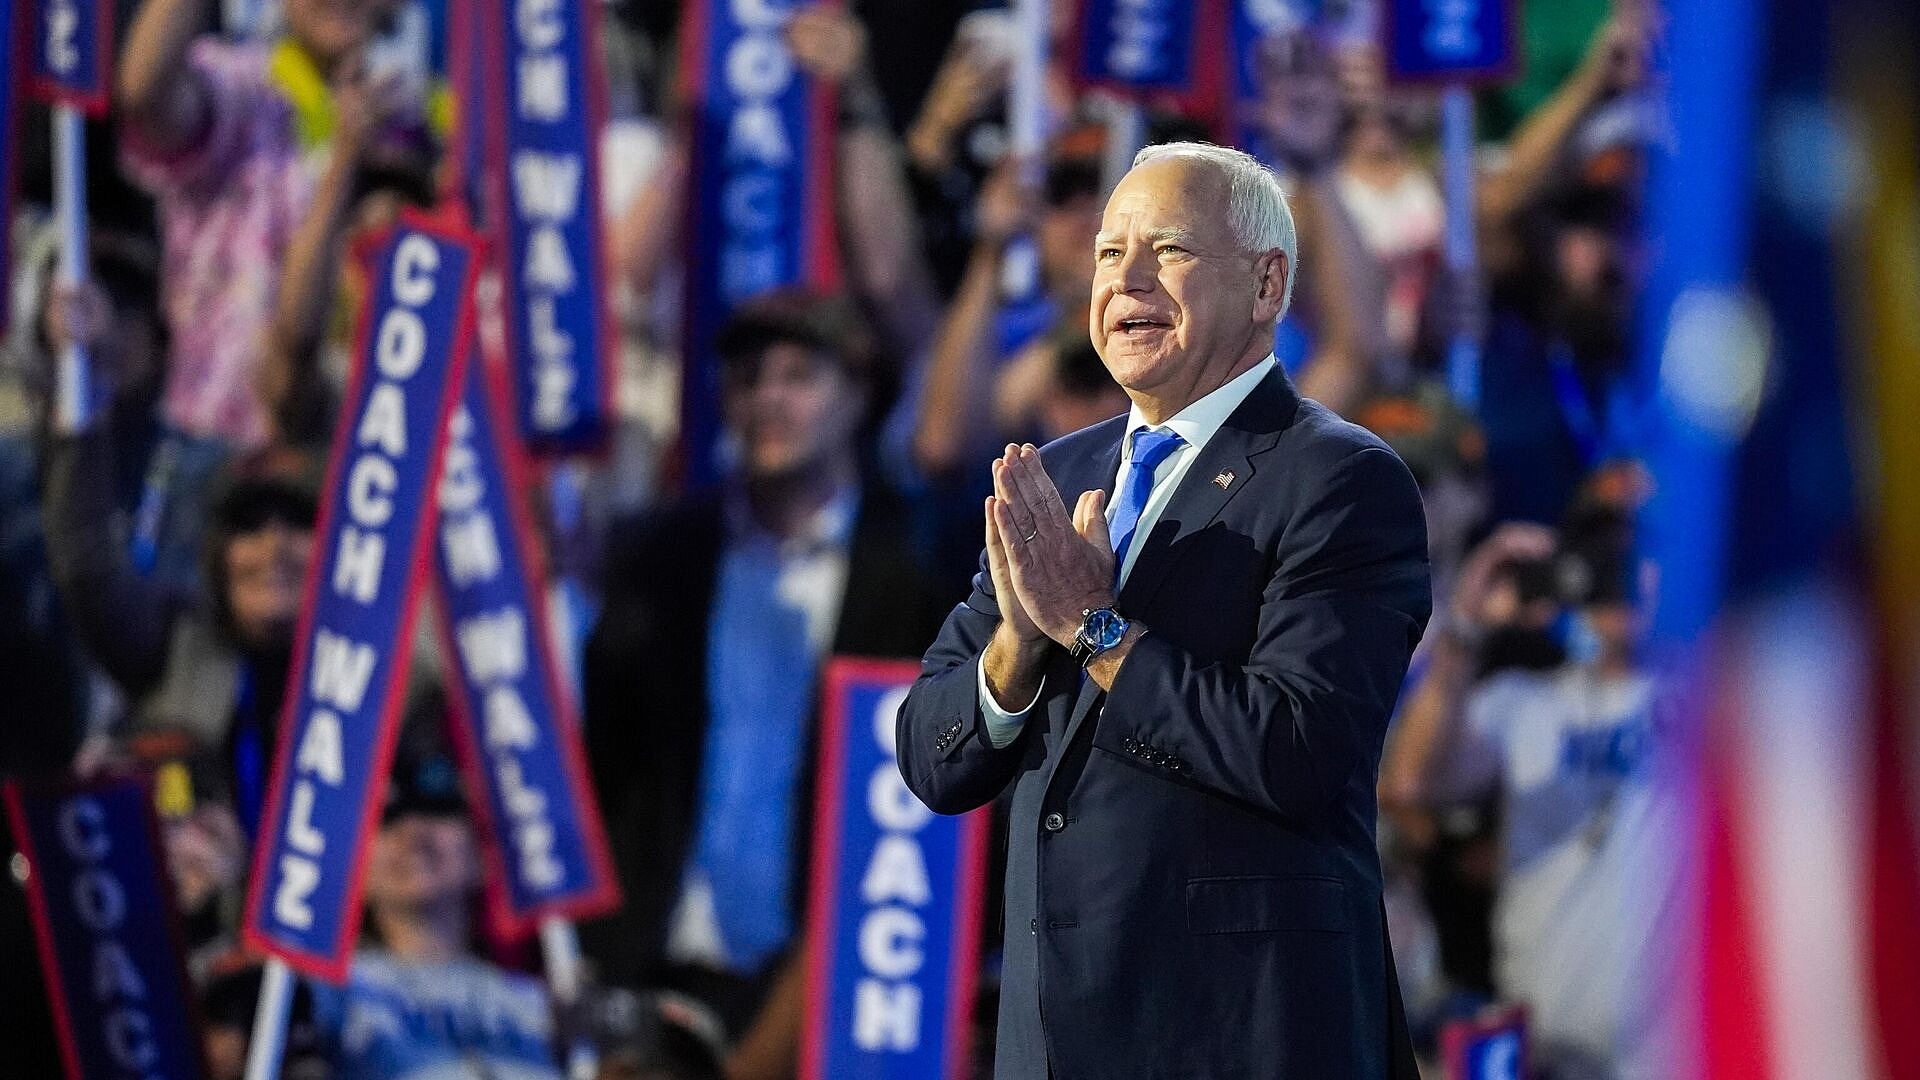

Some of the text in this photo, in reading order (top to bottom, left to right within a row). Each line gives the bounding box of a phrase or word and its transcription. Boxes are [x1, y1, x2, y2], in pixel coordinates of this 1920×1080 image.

[511, 150, 581, 431] WALZ
[273, 233, 440, 931] COACH WALZ
[457, 606, 563, 889] WALZ
[56, 794, 167, 1080] COAC
